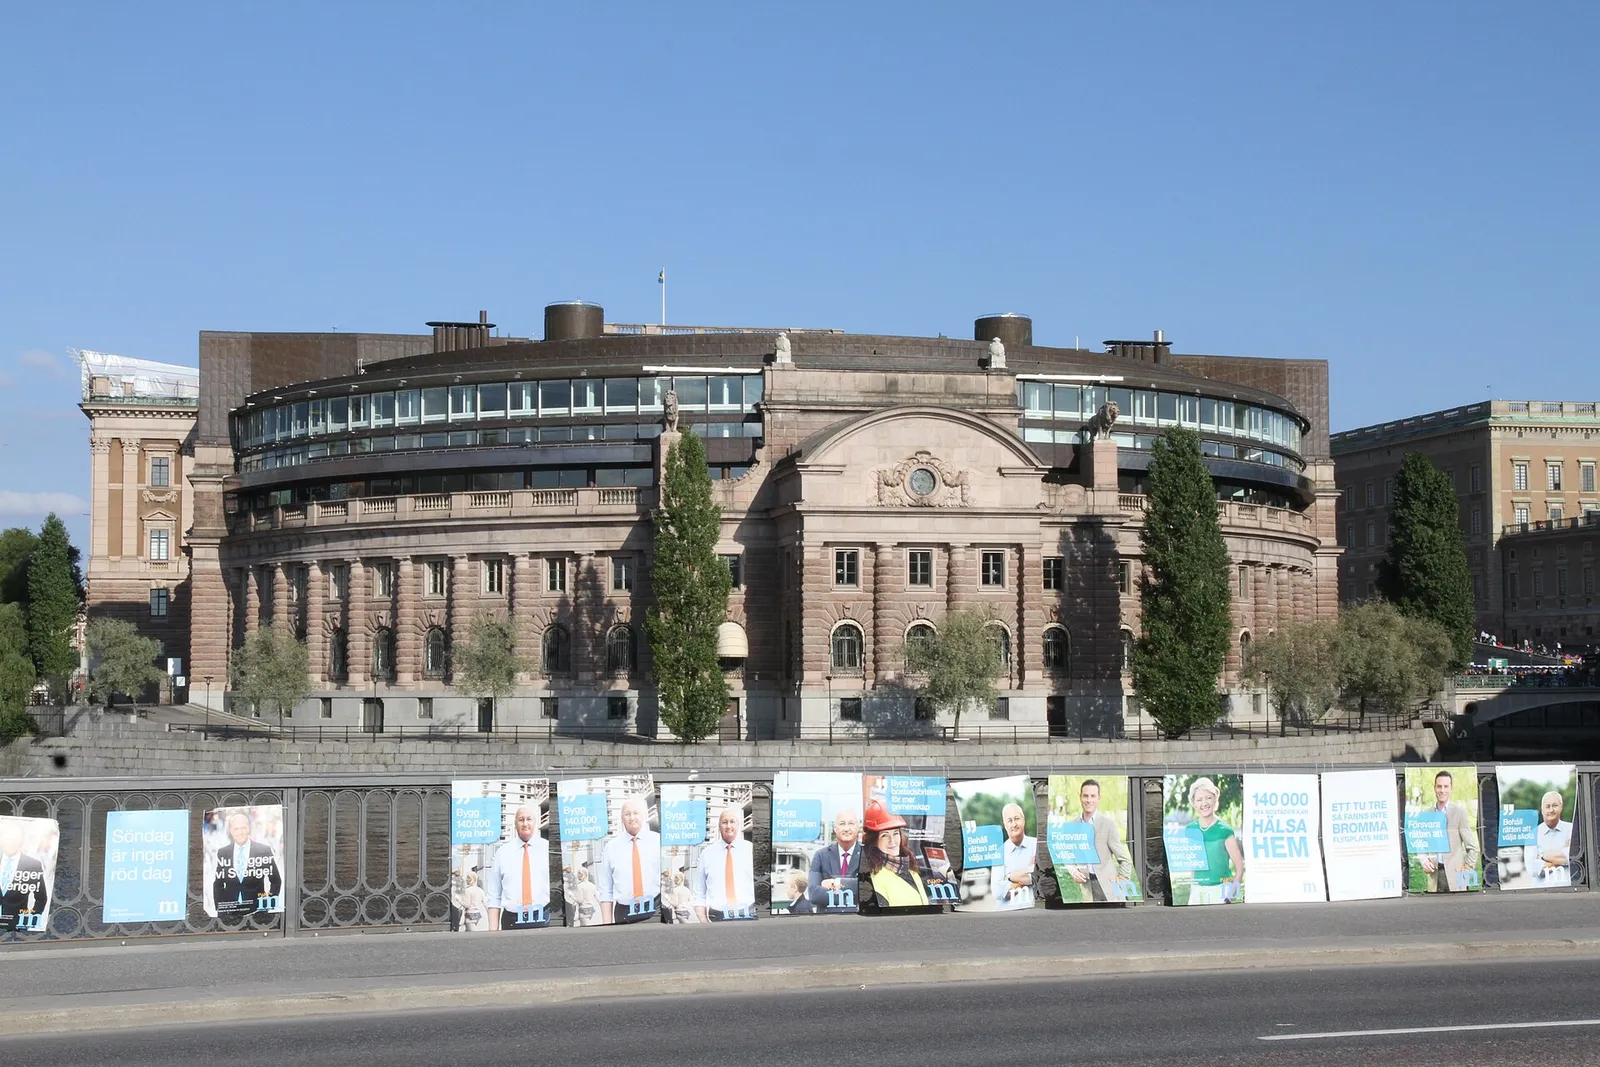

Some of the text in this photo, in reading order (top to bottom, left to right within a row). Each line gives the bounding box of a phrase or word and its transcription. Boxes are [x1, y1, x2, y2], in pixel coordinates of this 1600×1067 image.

[563, 806, 586, 816] Bygg
[1331, 800, 1388, 812] ETT TU TRE
[456, 808, 480, 819] Bygg
[665, 811, 687, 821] Bygg
[776, 808, 797, 818] Bygg
[1343, 812, 1369, 821] FANNS
[1370, 811, 1388, 819] INTE
[456, 819, 491, 828] 140.000
[564, 816, 597, 826] 140.000
[1252, 815, 1308, 833] HÄLSA
[1408, 820, 1441, 829] Försvara
[1503, 818, 1524, 826] Behåll
[564, 825, 601, 836] nya hem
[665, 822, 697, 831] 140.000
[1332, 821, 1389, 834] BROMMA
[112, 829, 174, 845] Söndag
[456, 829, 494, 839] nya hem
[665, 831, 700, 840] nya hem
[1051, 831, 1088, 841] Försvara
[1332, 833, 1389, 843] FLYGPLATS MER
[1432, 830, 1443, 838] att
[1502, 833, 1517, 841] välja
[967, 835, 988, 845] Behåll
[1410, 840, 1429, 849] välja
[988, 843, 998, 851] att
[1079, 842, 1091, 850] att
[1251, 836, 1310, 858] HEM
[111, 848, 174, 865] är ingen
[968, 853, 983, 863] välja
[1055, 851, 1076, 860] välja
[217, 857, 231, 867] Nu
[111, 866, 172, 883] röd dag
[216, 866, 273, 879] vi Sverige!
[158, 900, 179, 913] m
